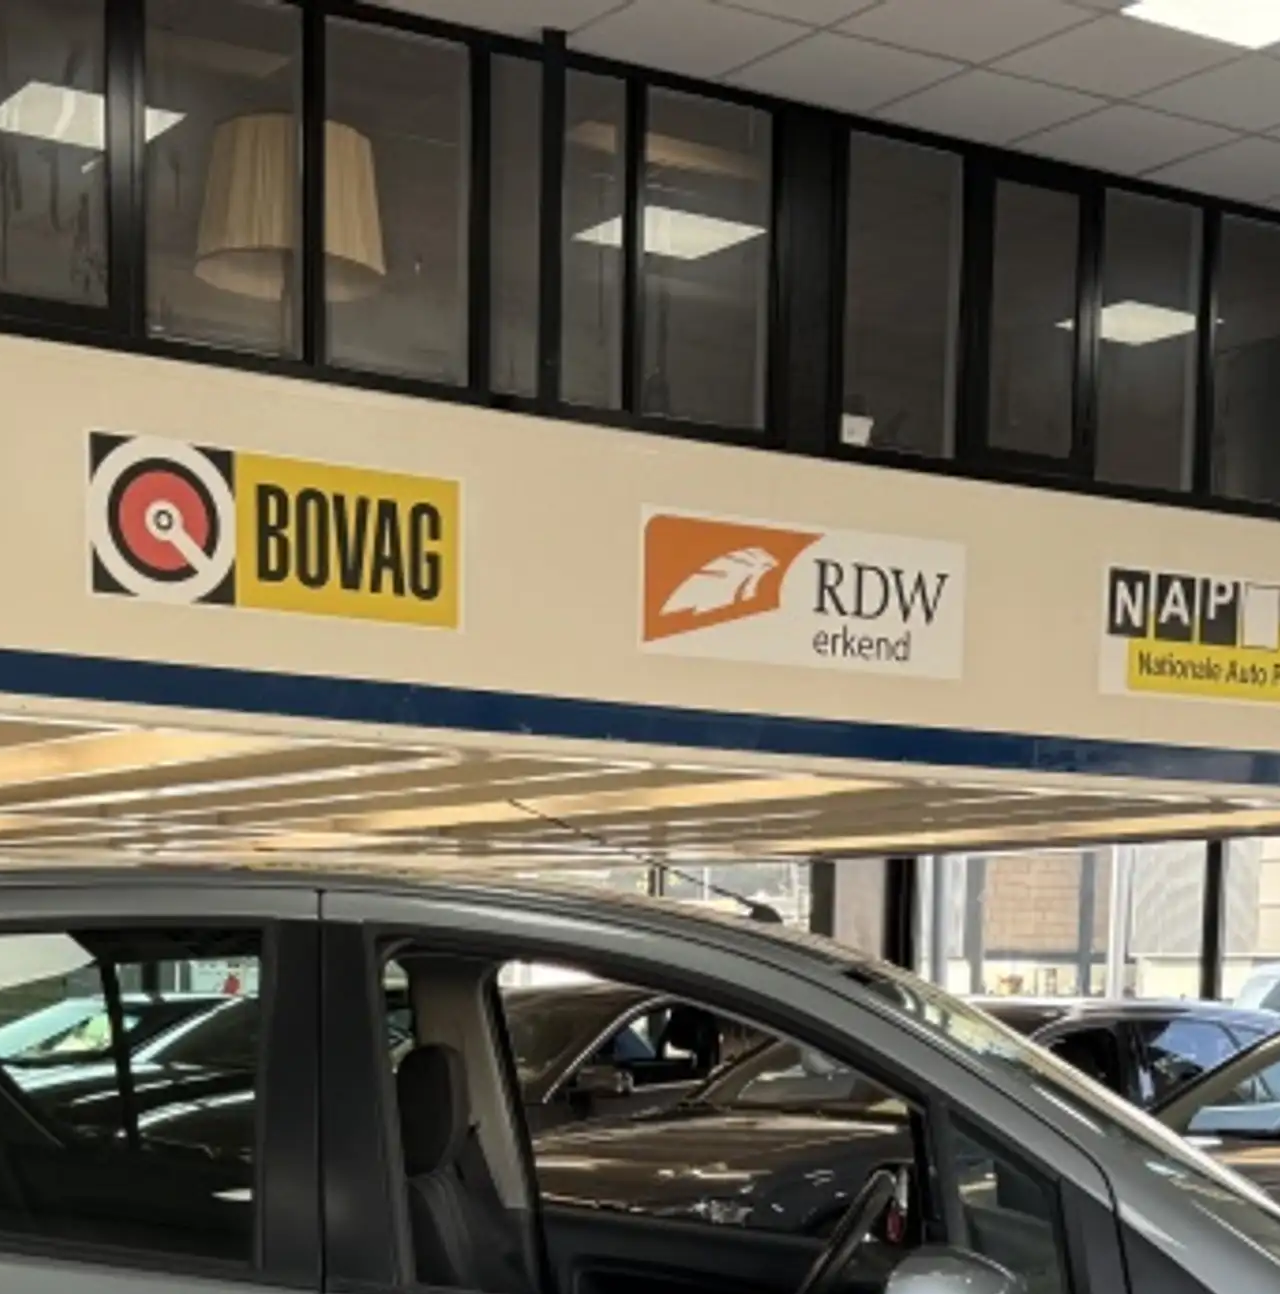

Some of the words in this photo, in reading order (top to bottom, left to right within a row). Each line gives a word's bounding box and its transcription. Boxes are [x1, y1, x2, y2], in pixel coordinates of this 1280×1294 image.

[256, 483, 442, 602] BOVAG
[812, 557, 950, 626] RDW
[1114, 578, 1236, 628] NAP
[811, 624, 912, 662] erkend
[1137, 650, 1221, 684] Nationale
[1225, 659, 1268, 688] Auto
